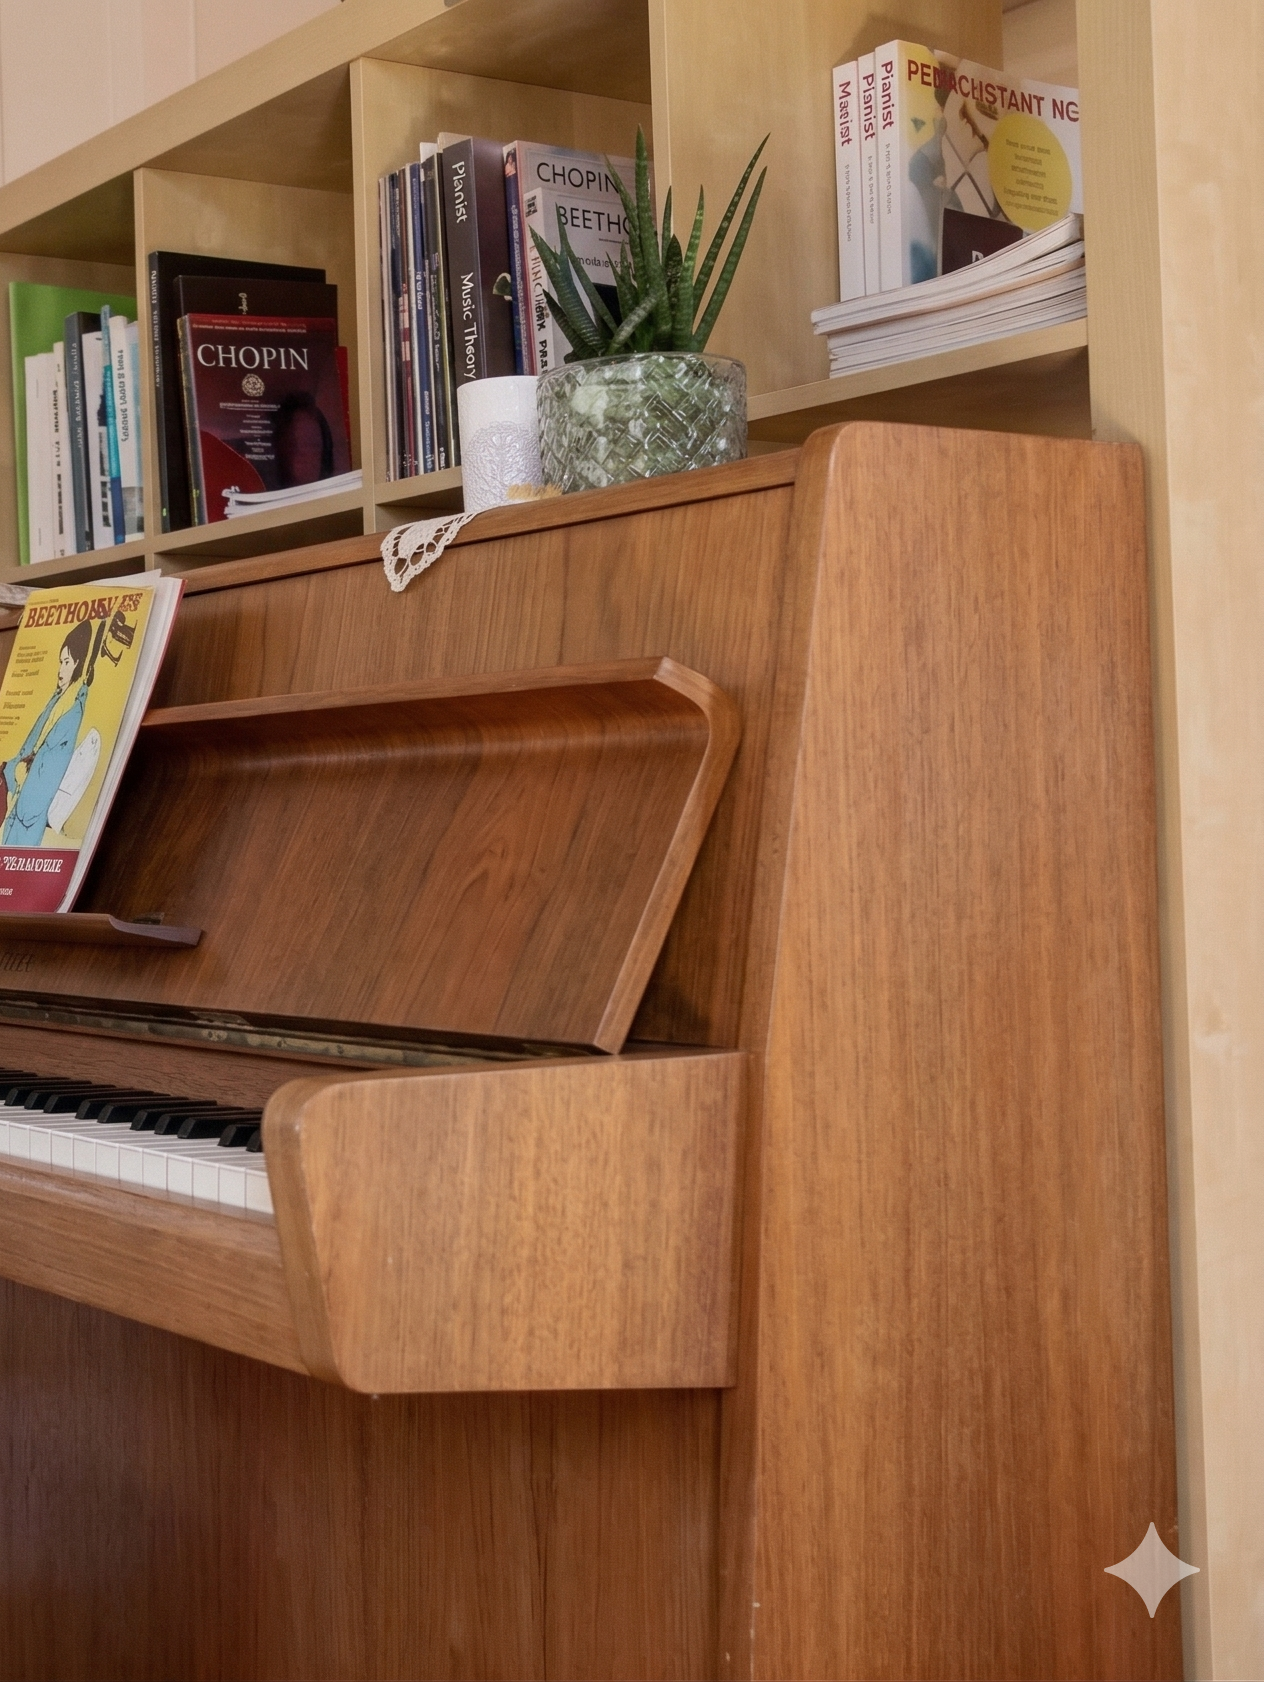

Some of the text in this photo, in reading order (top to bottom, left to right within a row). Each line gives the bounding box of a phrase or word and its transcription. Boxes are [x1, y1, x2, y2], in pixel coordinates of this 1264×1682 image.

[862, 73, 876, 141] Pianist
[881, 60, 895, 130] Pianist
[536, 162, 621, 194] CHOPIN
[460, 272, 475, 321] Music
[196, 343, 309, 371] CHOPIN
